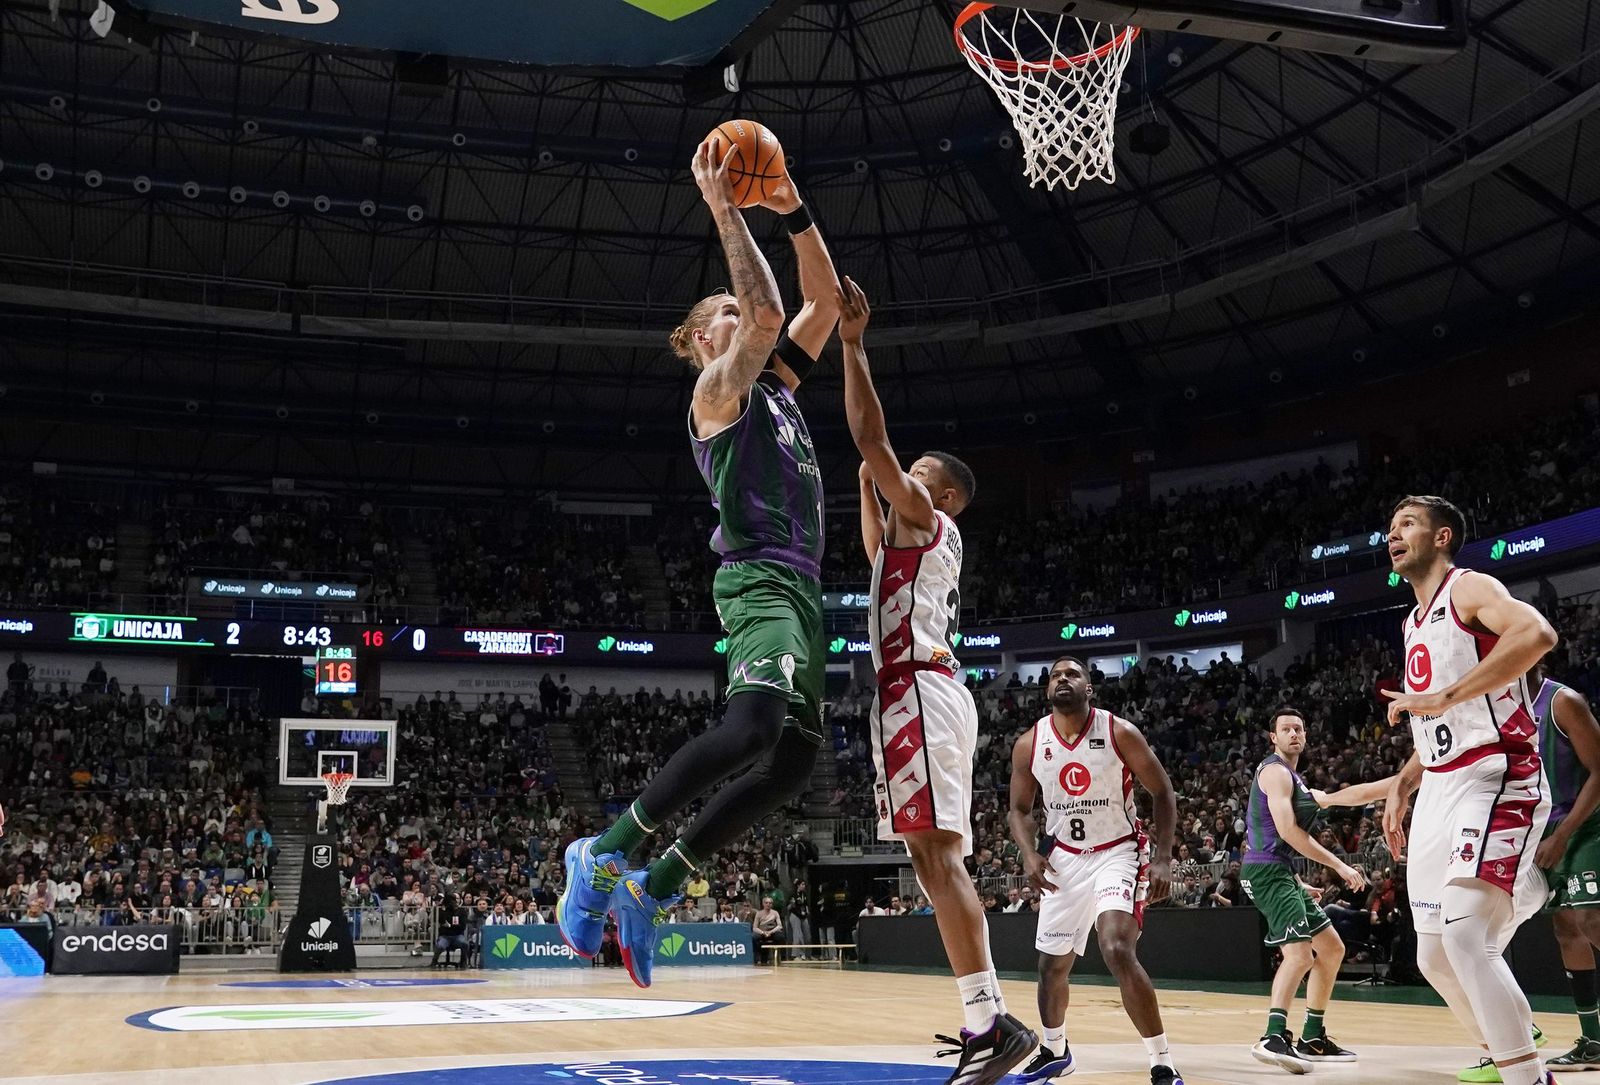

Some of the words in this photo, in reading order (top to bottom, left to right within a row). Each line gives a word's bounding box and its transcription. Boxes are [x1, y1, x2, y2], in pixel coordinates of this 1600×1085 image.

[1324, 543, 1350, 556] Unicaja
[1507, 536, 1545, 556] Unicaja
[217, 584, 246, 594] Unicaja
[275, 585, 302, 596] Unicaja
[329, 588, 356, 598] Unicaja
[1300, 589, 1335, 606] Unicaja
[1191, 609, 1228, 624] Unicaja
[112, 620, 183, 640] UNICAJA
[226, 622, 241, 645] 2
[283, 625, 331, 646] 8:43
[464, 630, 533, 643] CASADEMONT
[1078, 624, 1115, 637] Unicaja
[362, 630, 384, 647] 16
[412, 628, 426, 651] 0
[963, 634, 1000, 647] Unicaja
[325, 647, 352, 659] 8:43
[479, 641, 532, 654] ZARAGOZA
[616, 641, 653, 653] Unicaja
[325, 662, 352, 683] 16
[1070, 818, 1086, 841] 8
[62, 930, 168, 952] endesa
[301, 940, 338, 953] Unicaja
[523, 942, 580, 959] Unicaj
[688, 941, 745, 958] Unicaja
